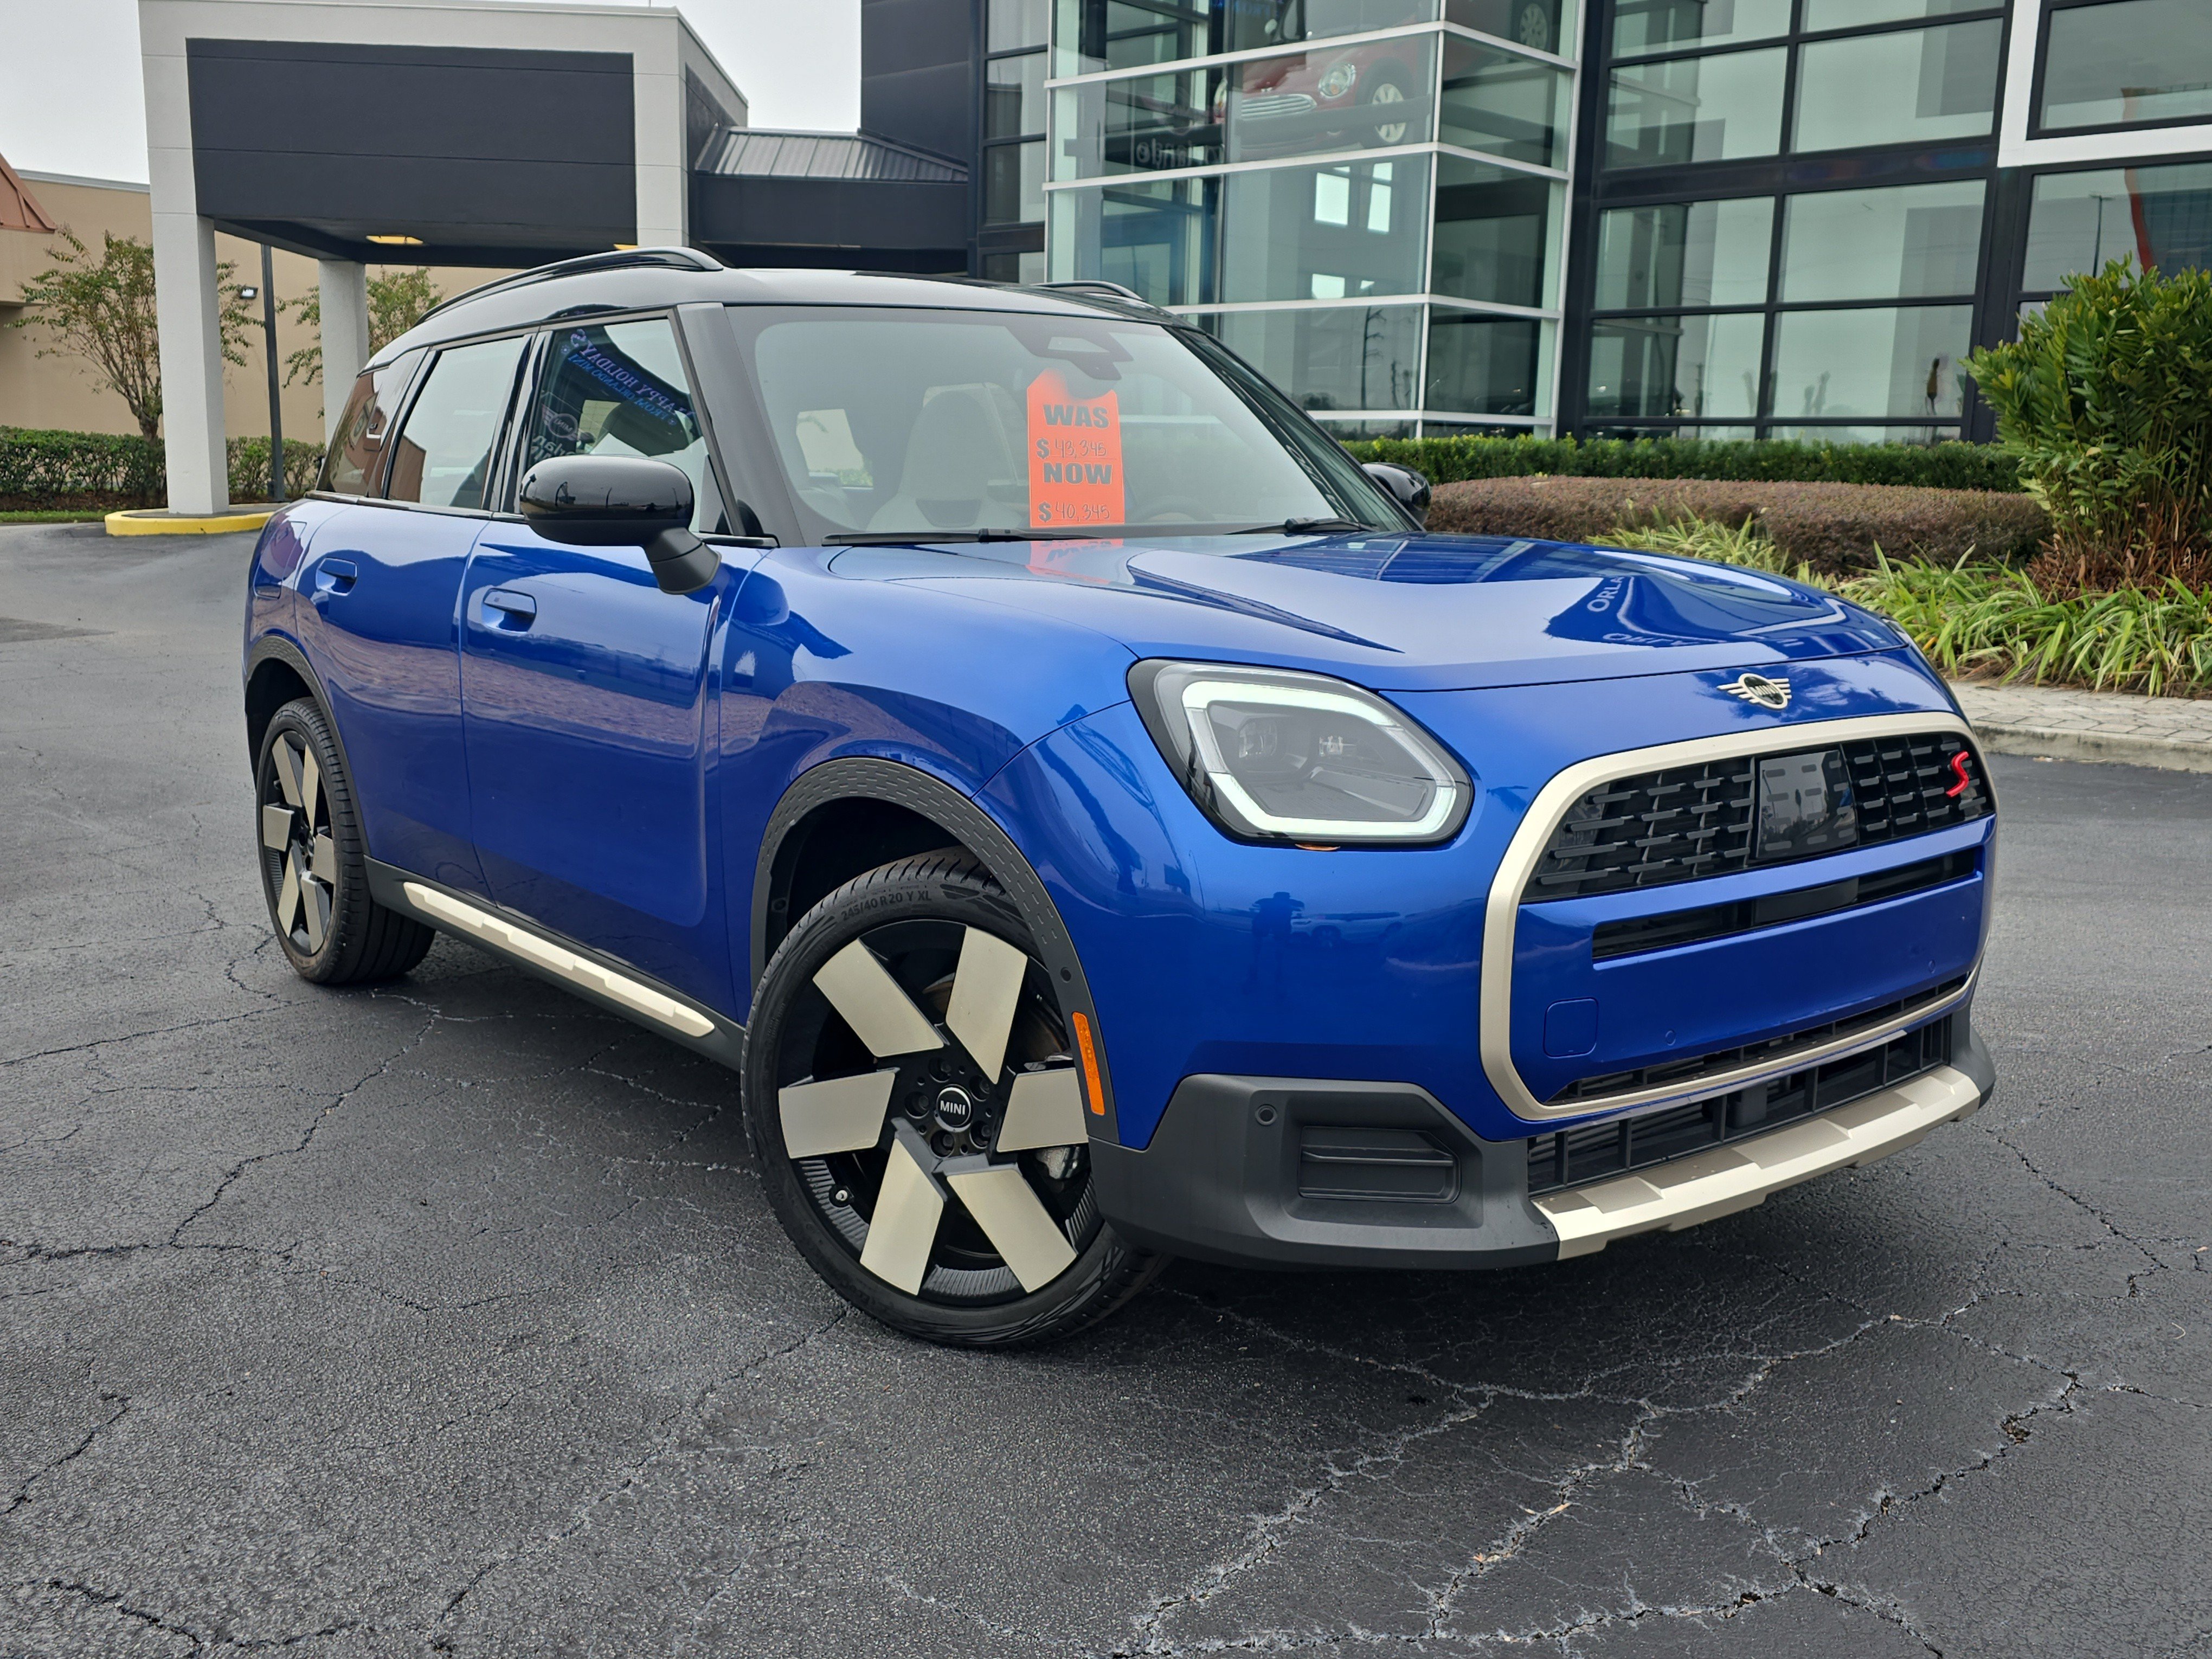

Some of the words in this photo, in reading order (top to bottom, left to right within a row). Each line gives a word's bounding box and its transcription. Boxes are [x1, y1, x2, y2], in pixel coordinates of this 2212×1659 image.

[1043, 404, 1109, 429] WAS
[1043, 462, 1112, 485] NOW
[1748, 684, 1778, 697] MINI
[1945, 750, 1970, 798] S
[841, 899, 878, 921] 245/40
[906, 891, 914, 902] Y
[917, 890, 932, 901] XL
[940, 1099, 966, 1116] MINI
